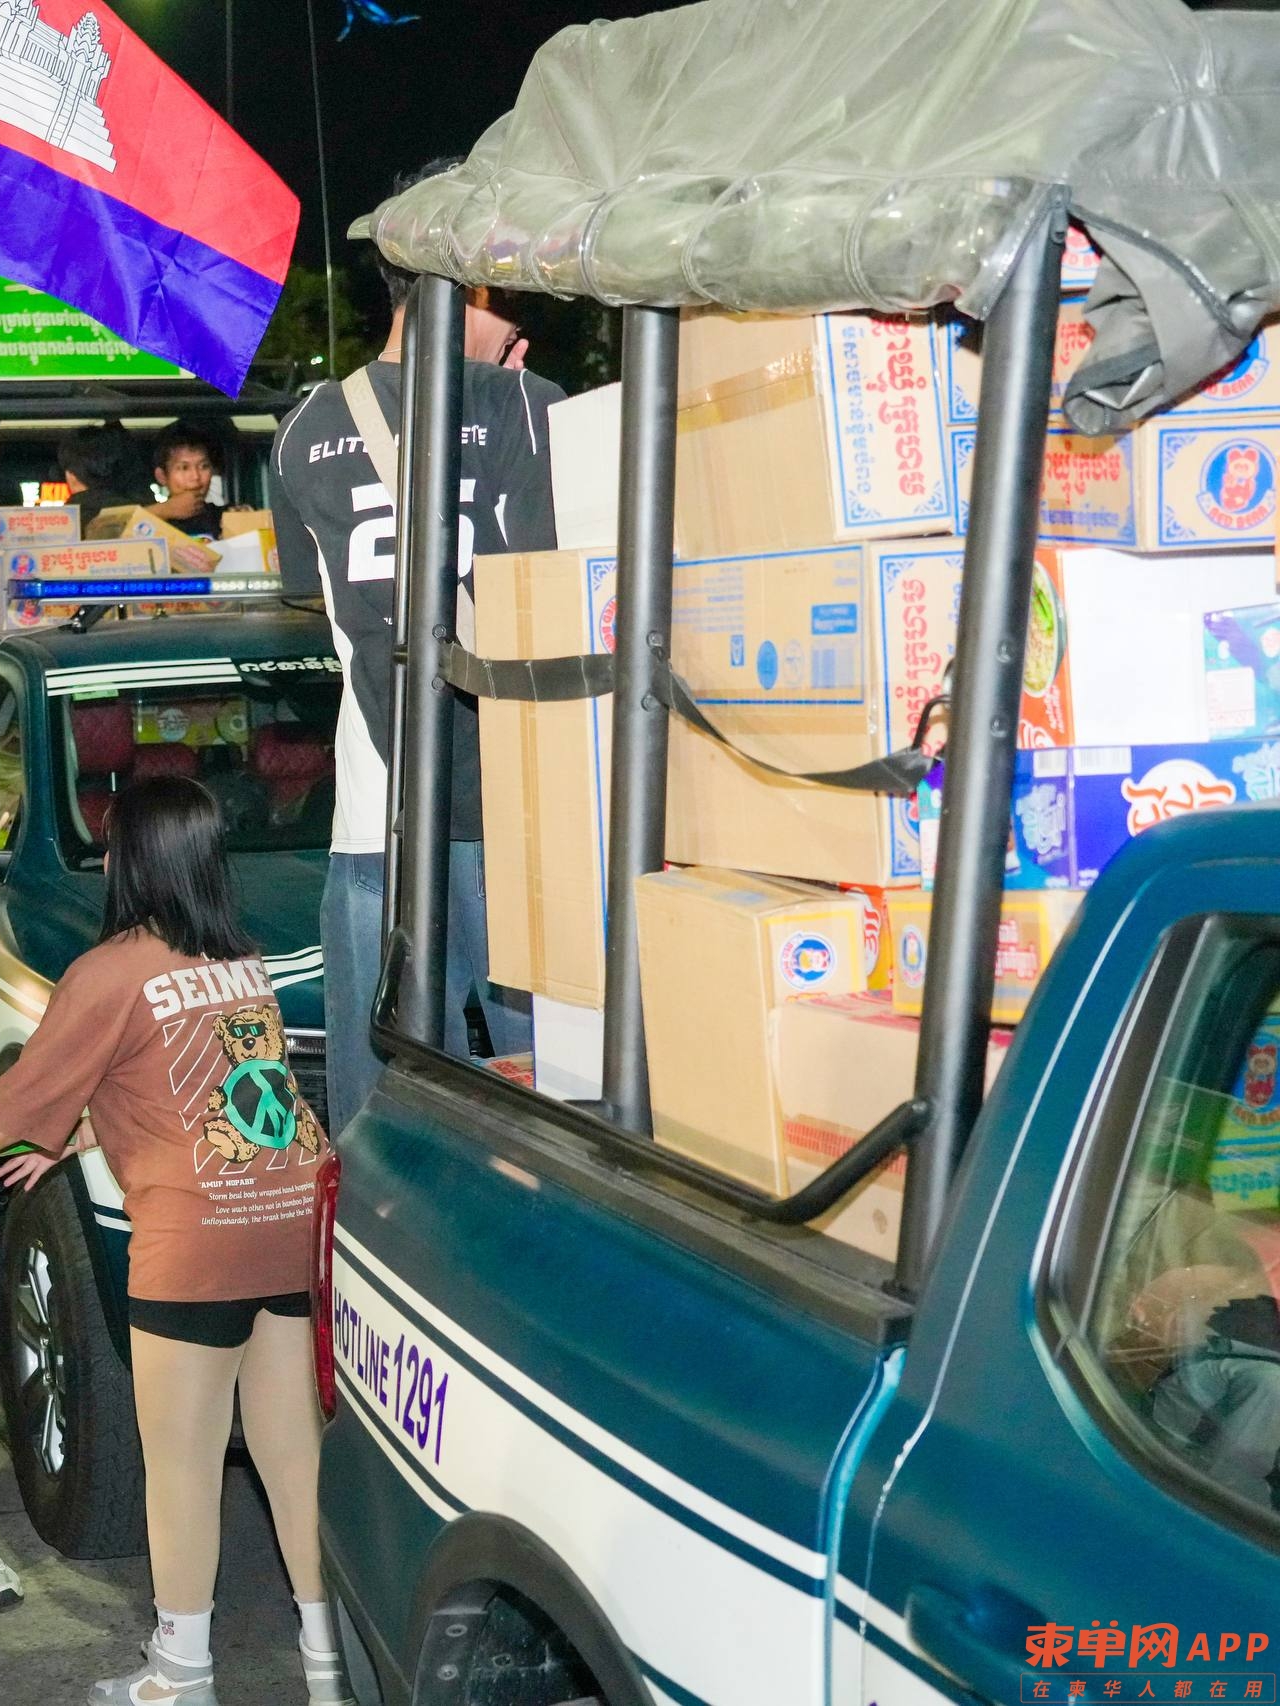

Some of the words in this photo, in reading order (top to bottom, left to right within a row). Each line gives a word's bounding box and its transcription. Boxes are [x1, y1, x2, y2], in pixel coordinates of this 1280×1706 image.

[308, 437, 370, 463] ELIT
[334, 1287, 390, 1408] HOTLINE
[393, 1333, 449, 1466] 1291
